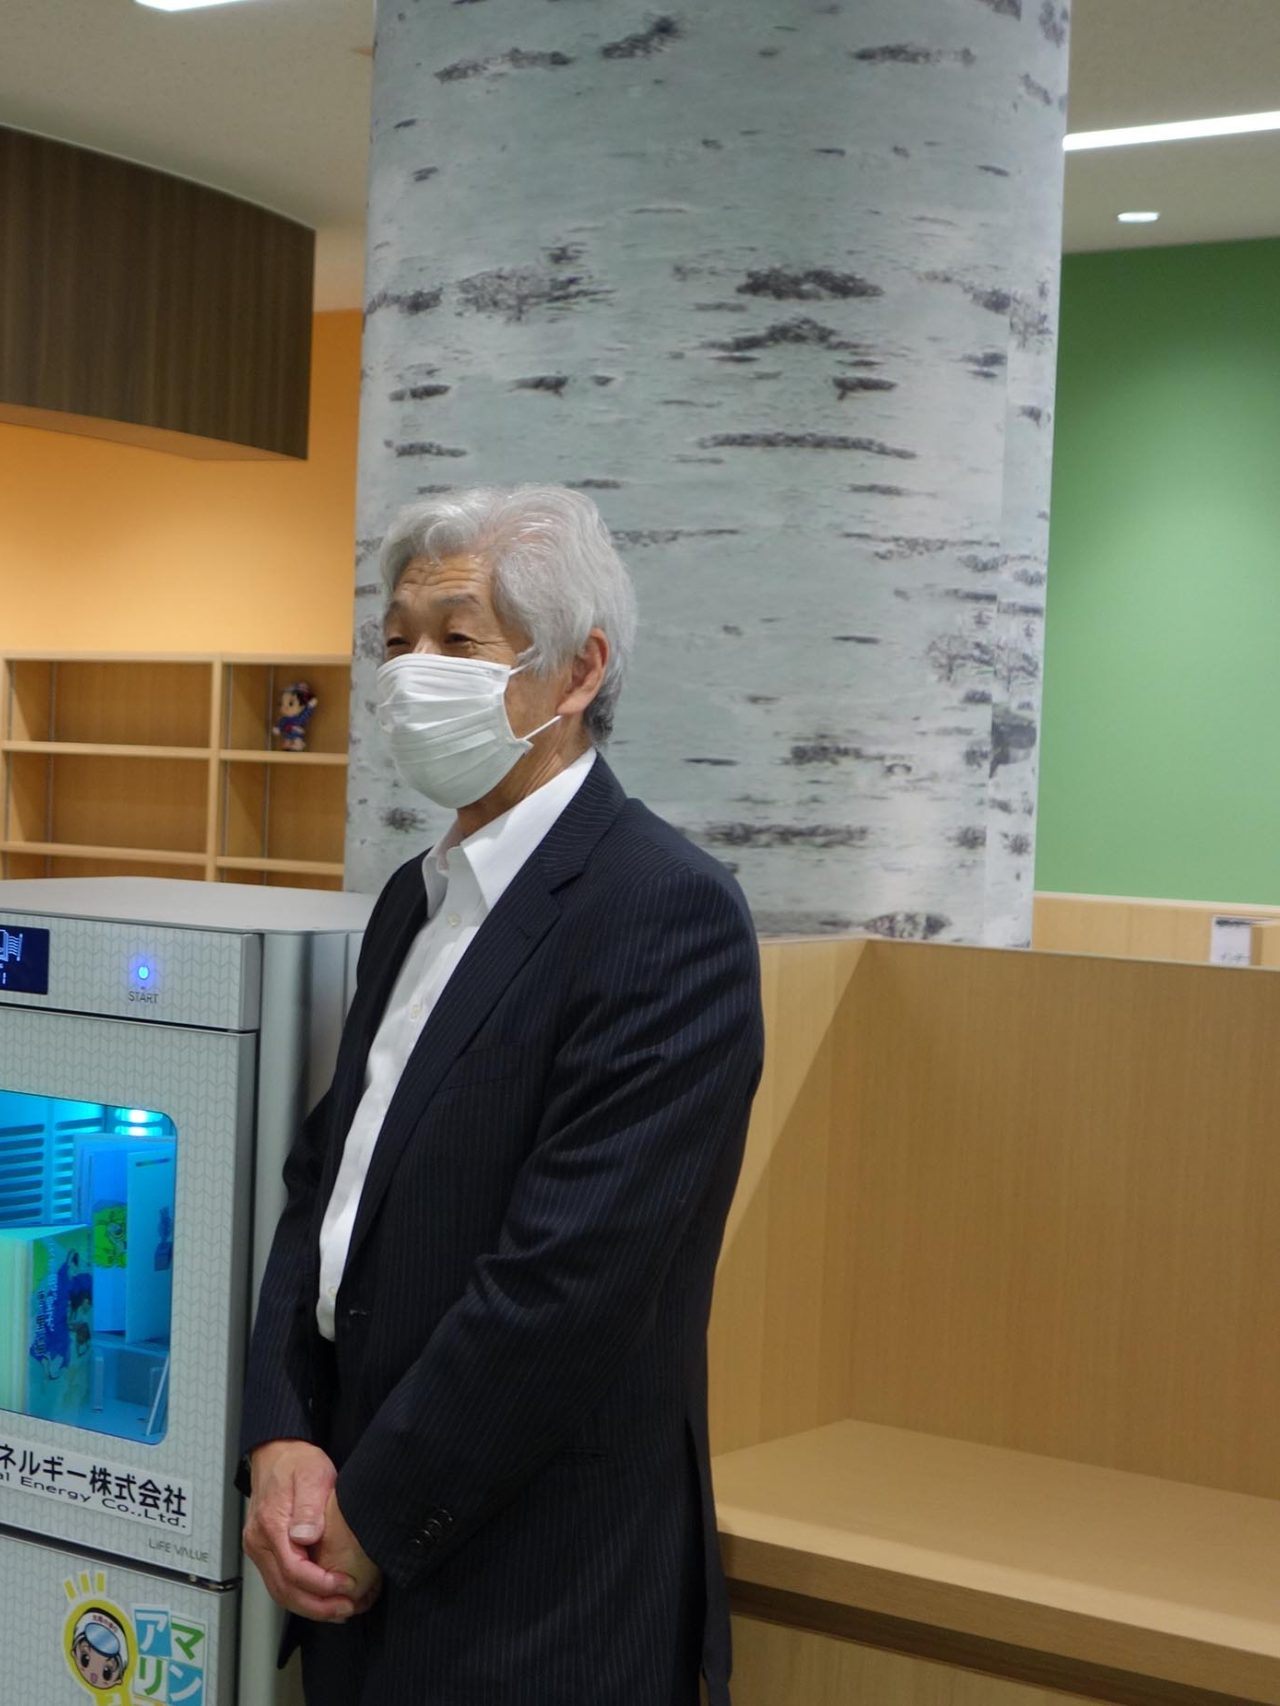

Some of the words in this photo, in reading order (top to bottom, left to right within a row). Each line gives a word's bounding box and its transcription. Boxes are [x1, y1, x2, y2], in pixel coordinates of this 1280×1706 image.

[127, 990, 160, 1004] START
[20, 1476, 91, 1503] Energy
[174, 1544, 209, 1563] VALUE
